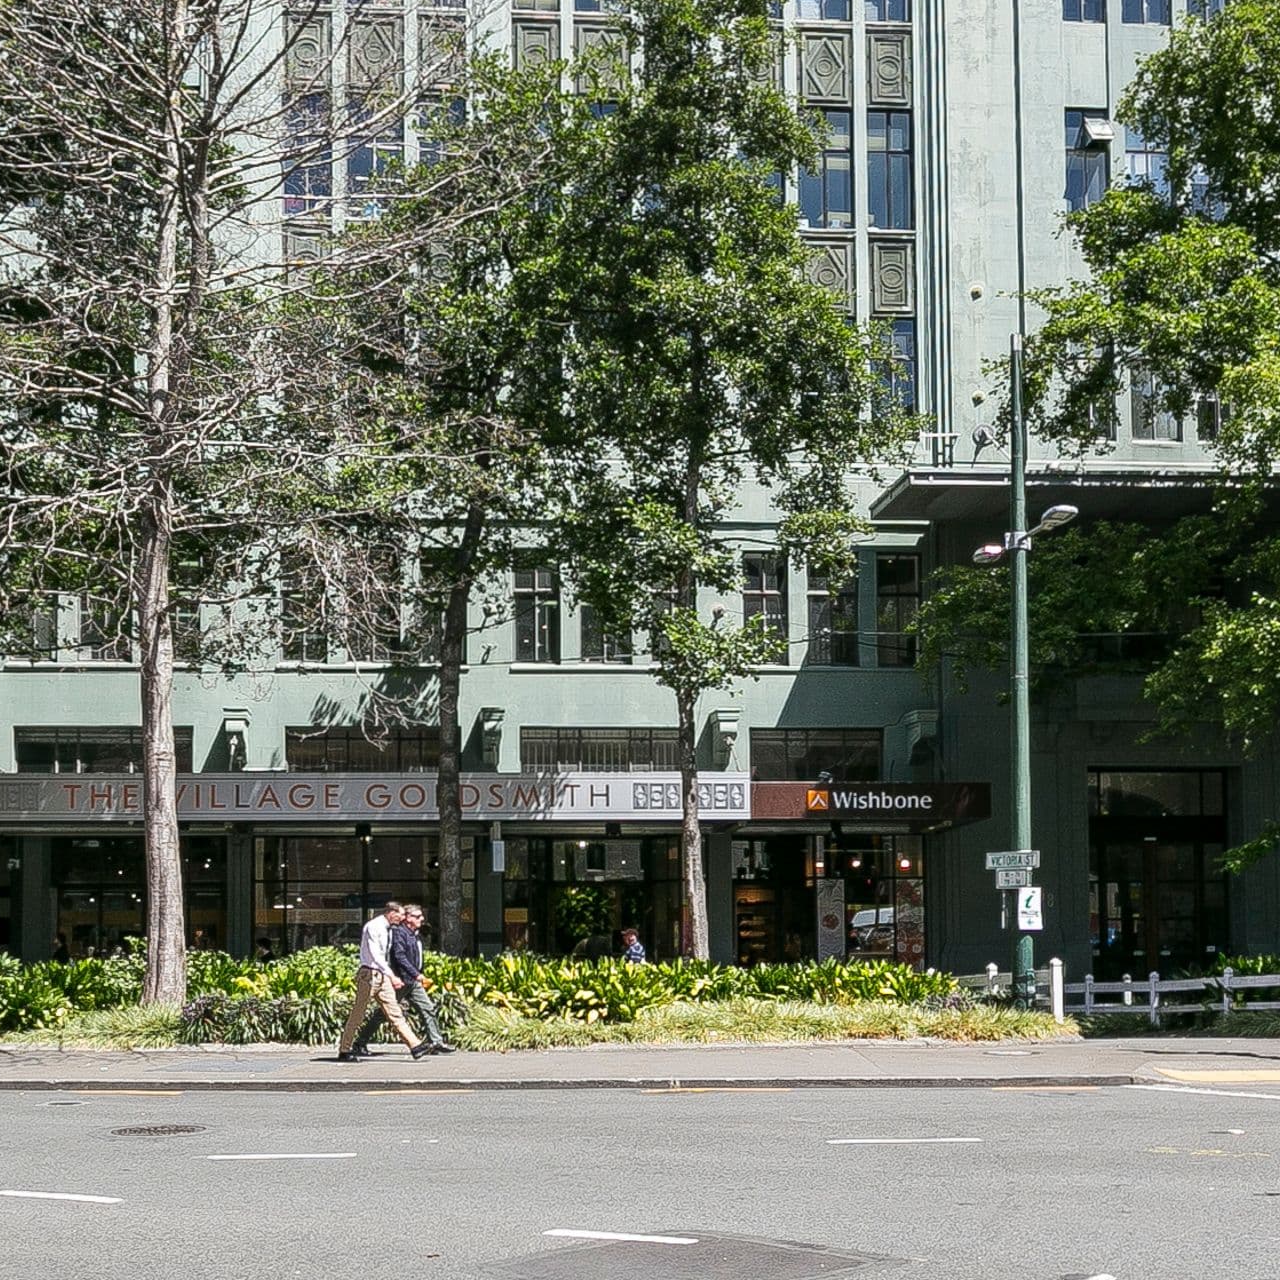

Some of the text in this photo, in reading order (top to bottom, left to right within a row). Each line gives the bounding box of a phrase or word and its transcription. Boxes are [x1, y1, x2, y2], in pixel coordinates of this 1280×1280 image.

[63, 784, 138, 809] THE
[365, 783, 610, 809] GODSMITH
[832, 790, 933, 810] Wishbone
[1025, 854, 1035, 865] ST
